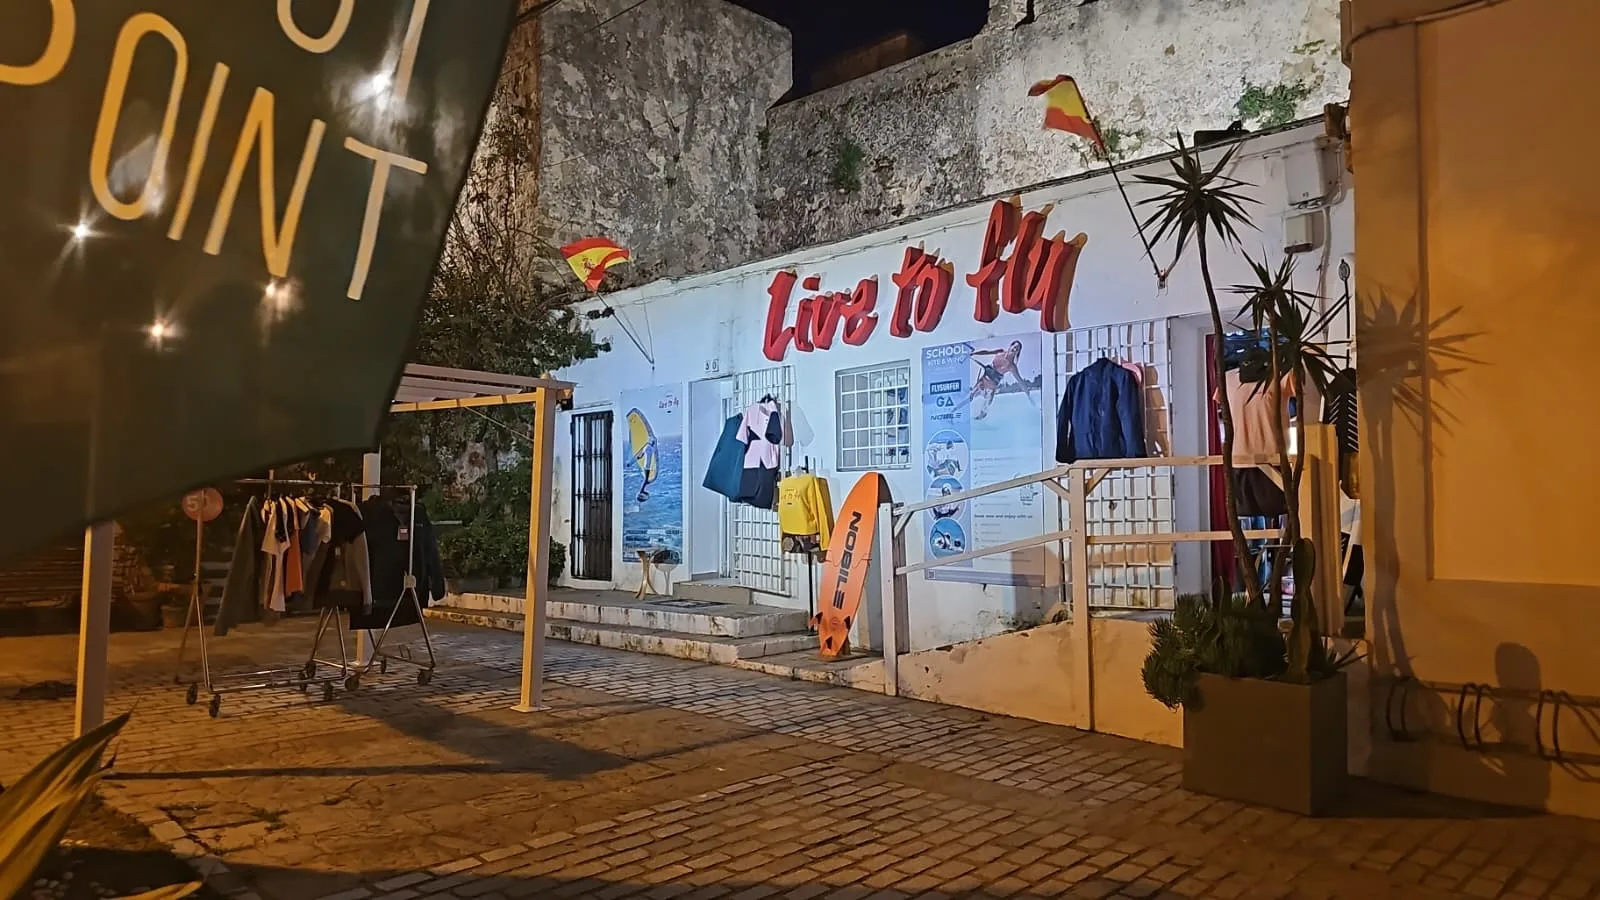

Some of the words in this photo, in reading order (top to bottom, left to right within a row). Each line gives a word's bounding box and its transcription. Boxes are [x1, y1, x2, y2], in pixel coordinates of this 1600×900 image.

[762, 268, 879, 362] Live
[889, 244, 954, 338] to
[966, 197, 1082, 333] fly
[926, 344, 968, 359] SCHOOL
[931, 383, 960, 392] FLYSURFER
[832, 510, 863, 610] NOBILE
